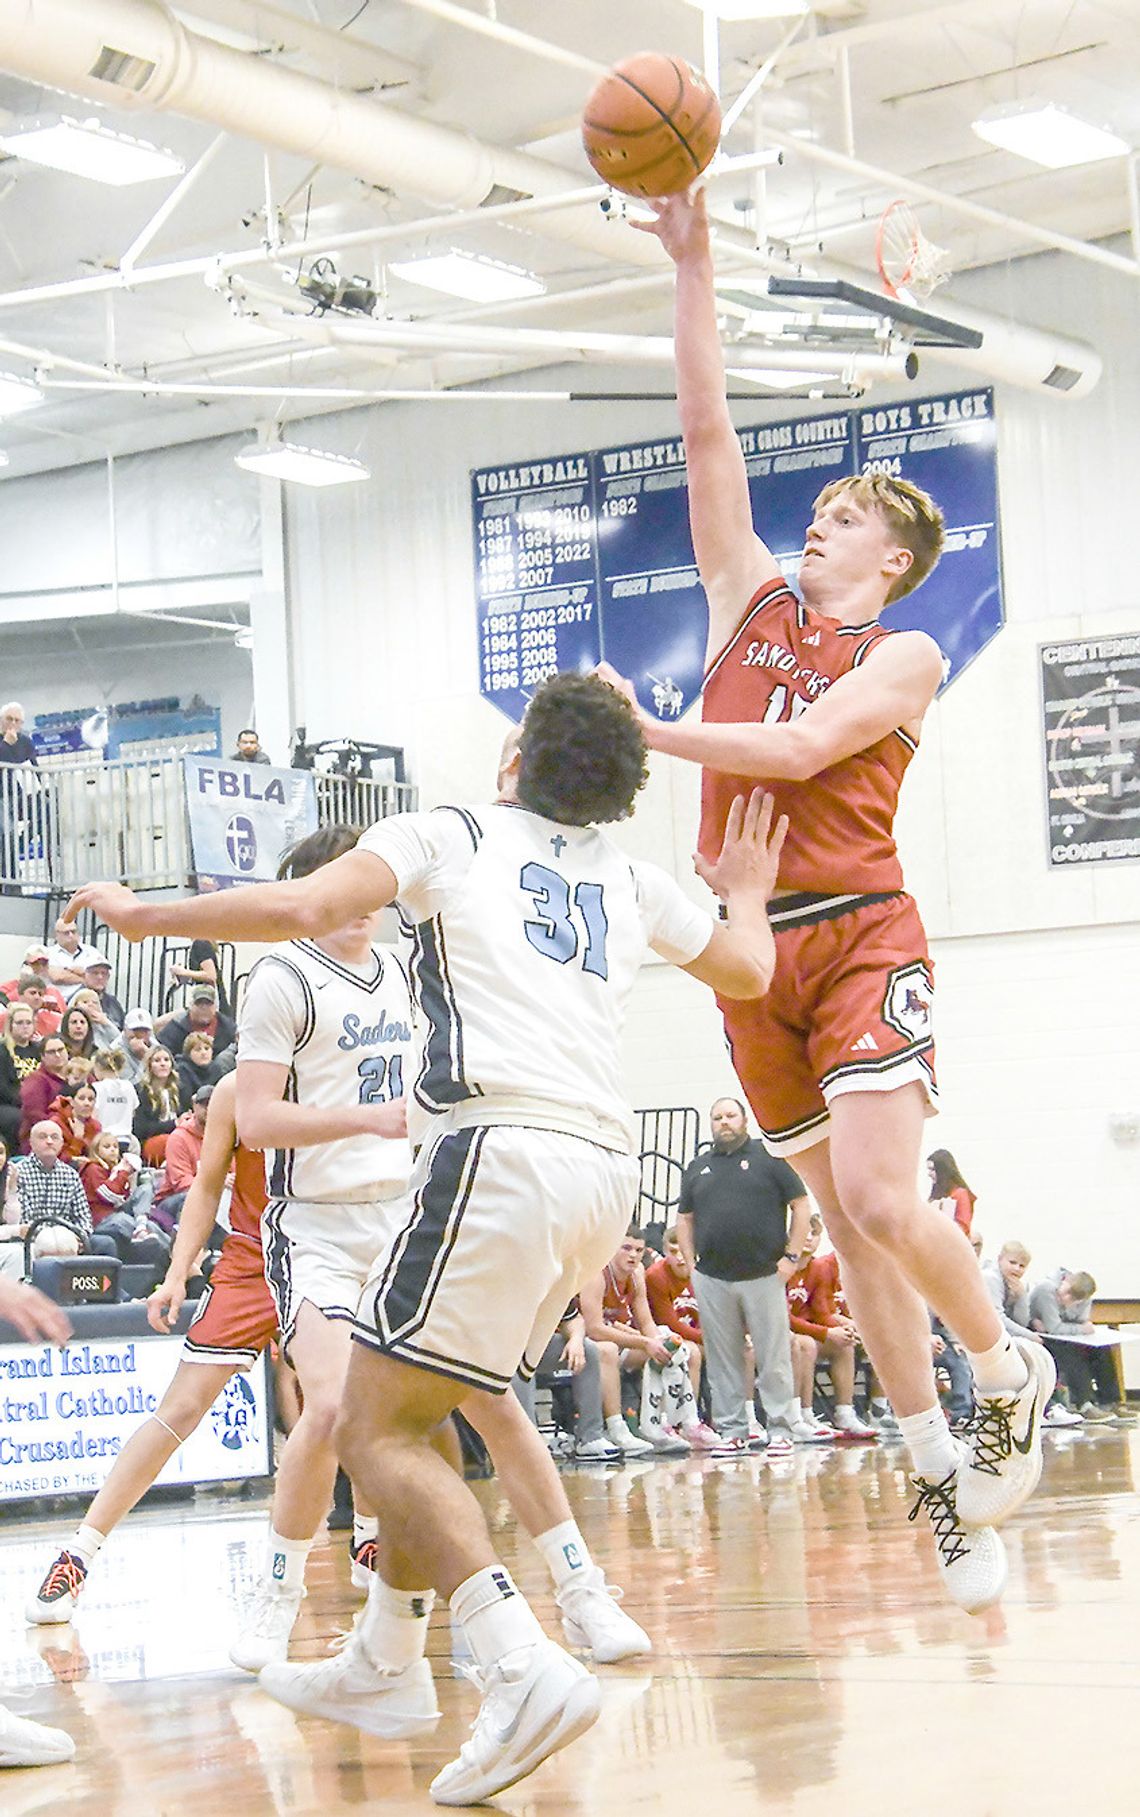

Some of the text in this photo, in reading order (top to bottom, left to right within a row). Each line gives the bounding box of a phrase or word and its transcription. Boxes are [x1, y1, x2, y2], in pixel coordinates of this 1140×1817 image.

[861, 394, 988, 434] BOYS TRACK
[740, 416, 848, 453] YS CROSS COUNTRY
[476, 458, 589, 494] VOLLEYBALL
[861, 457, 902, 476] 2004
[478, 516, 511, 537] 1981
[554, 504, 590, 525] 2010
[601, 496, 637, 518] 1982
[480, 535, 513, 556] 1987
[518, 548, 554, 569] 2005
[555, 543, 591, 563] 2022
[518, 567, 554, 588] 2007
[482, 603, 593, 635] 1982 2002 2017
[483, 627, 557, 654] 1984 2006
[198, 767, 286, 805] FBLA
[519, 861, 609, 982] 31
[337, 1008, 412, 1051] Saders
[357, 1054, 404, 1105] 21
[59, 1343, 136, 1376] Island
[55, 1386, 157, 1419] Catholic
[0, 1430, 122, 1465] Crusaders
[53, 1475, 70, 1489] BY
[75, 1472, 99, 1487] THE
